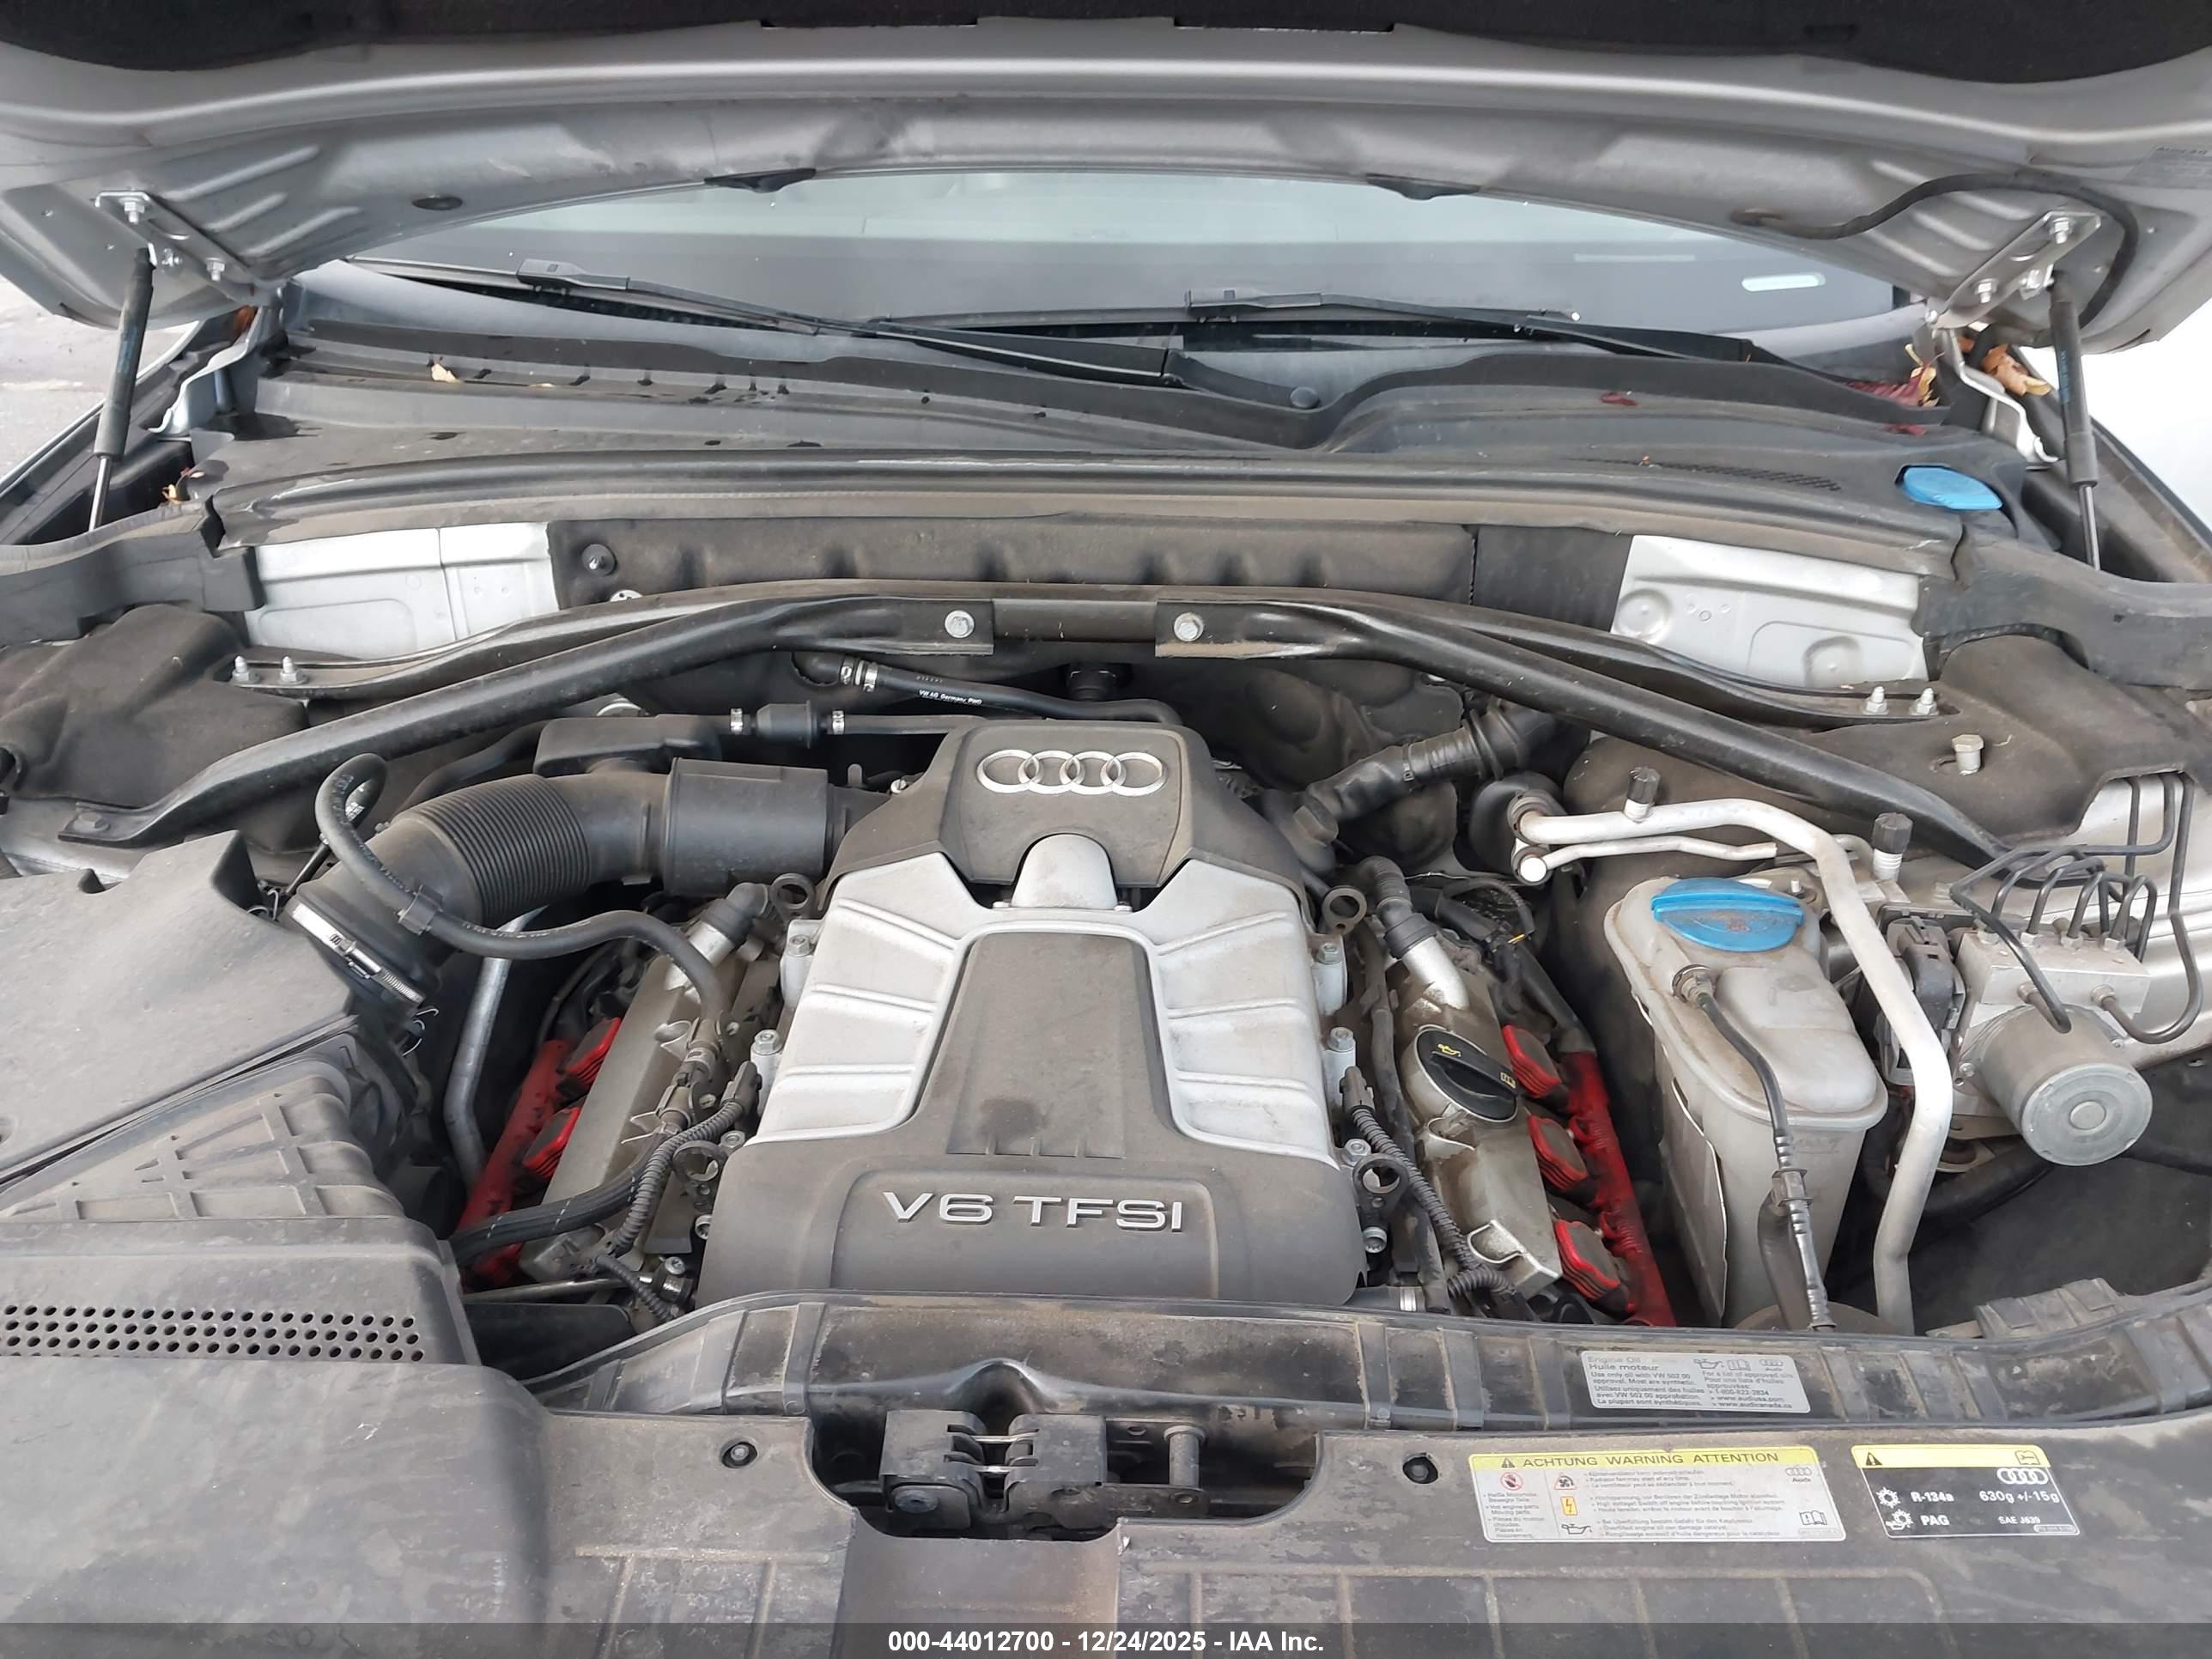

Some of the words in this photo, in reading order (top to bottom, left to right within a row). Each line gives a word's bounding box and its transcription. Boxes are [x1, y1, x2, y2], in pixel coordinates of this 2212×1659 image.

[883, 1192, 995, 1225] V6
[1013, 1194, 1183, 1233] TFSI
[1522, 1456, 1598, 1467] ACHTUNG
[1605, 1455, 1684, 1465] WARNING
[1692, 1453, 1779, 1463] ATTENTION
[1910, 1492, 1955, 1502] R-134a
[1978, 1491, 2014, 1504] 630g
[1920, 1515, 1951, 1526] PAG
